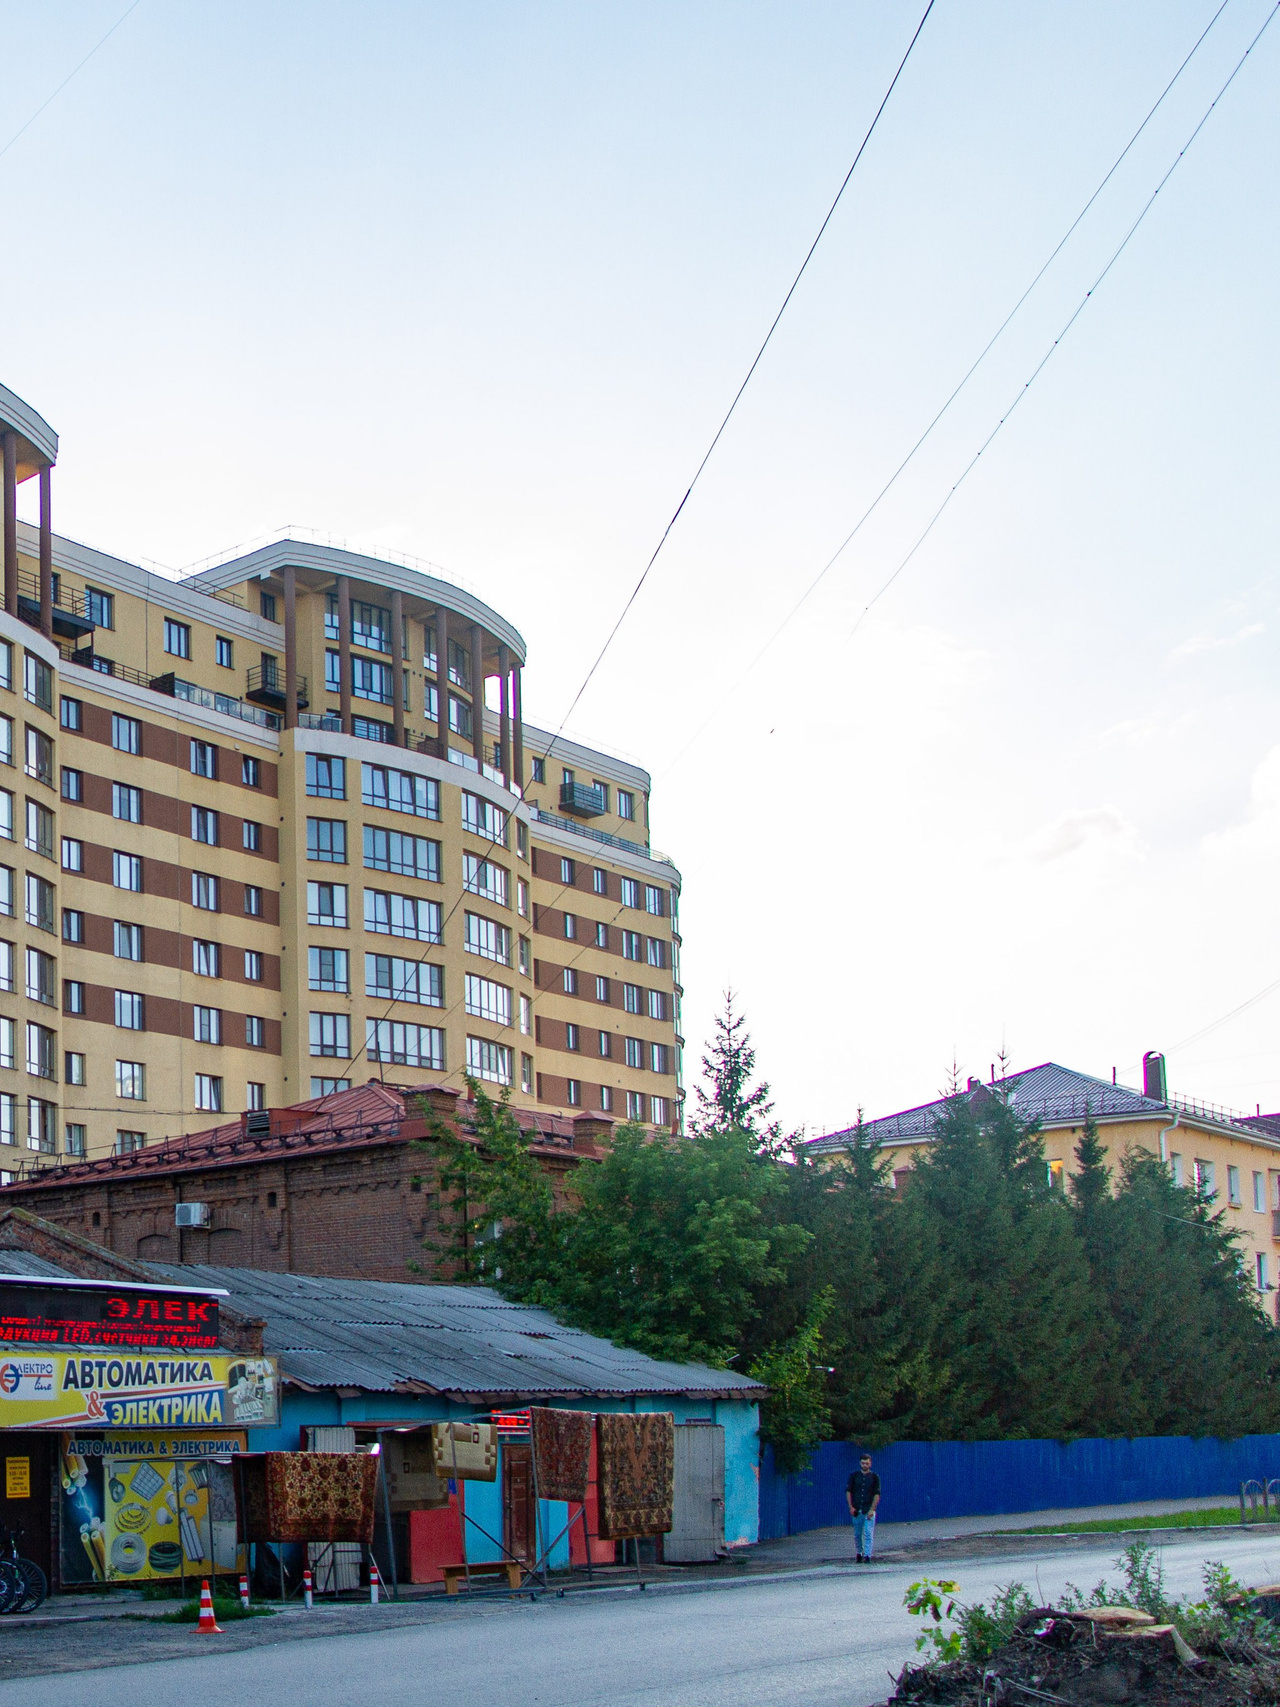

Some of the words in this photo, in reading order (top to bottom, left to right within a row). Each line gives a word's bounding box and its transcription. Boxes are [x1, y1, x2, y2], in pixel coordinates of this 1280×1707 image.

[107, 1298, 219, 1322] ЭЛЕК
[34, 1377, 52, 1390] line
[62, 1359, 213, 1390] АВТОМАТИКА
[86, 1391, 105, 1418] &
[111, 1391, 223, 1425] ЭЛЕКТРИКА
[67, 1439, 155, 1457] АВТОМАТИКА
[158, 1440, 168, 1455] &
[171, 1439, 241, 1455] ЭЛЕКТРИКА
